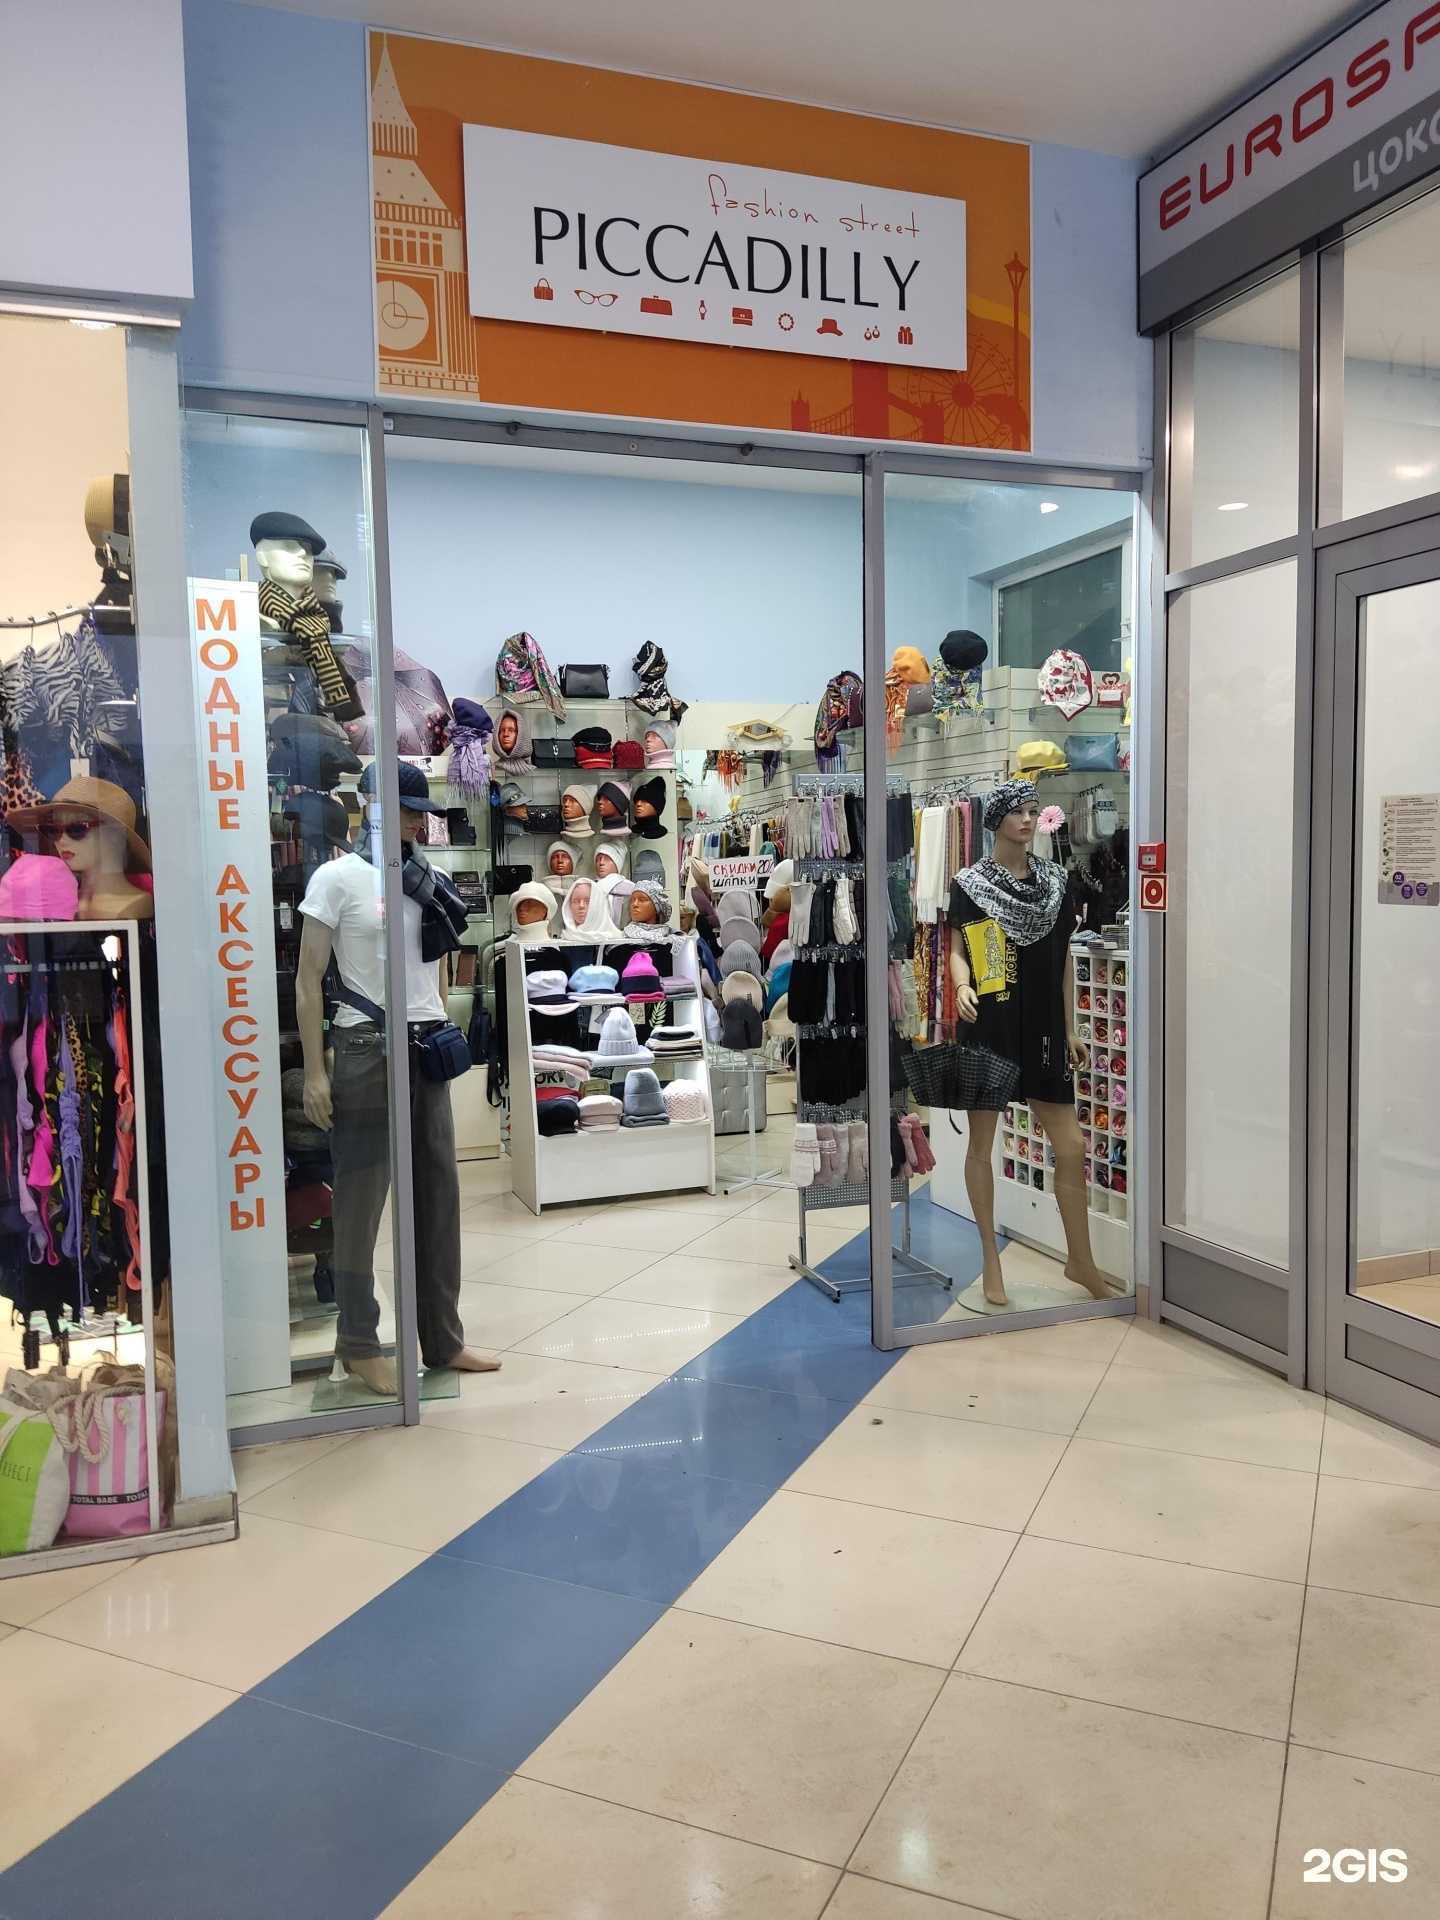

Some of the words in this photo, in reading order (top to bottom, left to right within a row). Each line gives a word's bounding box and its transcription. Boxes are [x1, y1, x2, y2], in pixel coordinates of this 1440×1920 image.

[534, 206, 920, 311] PICCADILLY
[708, 174, 818, 223] fashion
[839, 203, 920, 238] street
[195, 598, 245, 830] МОДНЫЕ
[1006, 943, 1017, 983] MEOW
[215, 864, 265, 1231] АКСЕССУАРЫ
